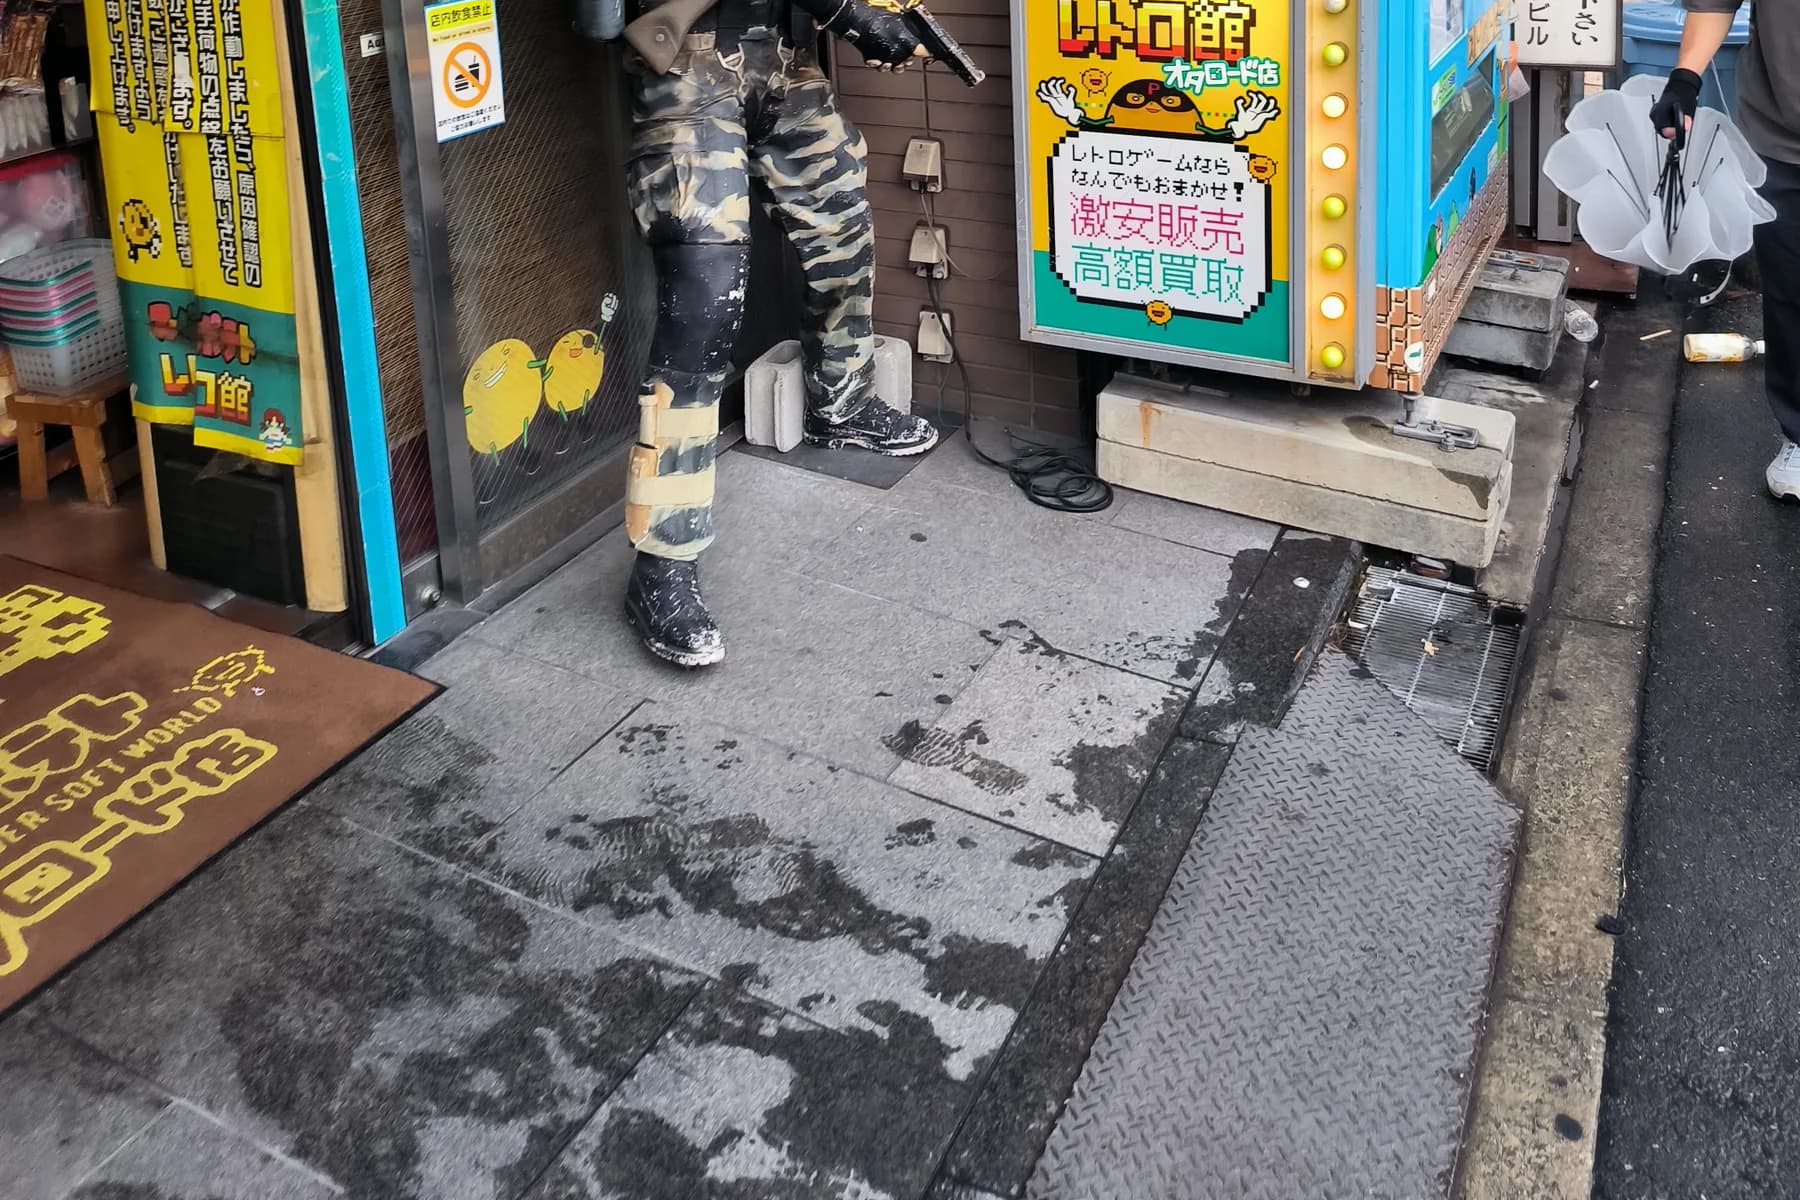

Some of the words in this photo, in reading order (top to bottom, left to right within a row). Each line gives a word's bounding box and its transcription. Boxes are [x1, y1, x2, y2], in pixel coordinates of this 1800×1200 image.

[1162, 56, 1281, 96] オタロード店
[1071, 143, 1231, 176] レトロゲームなら
[1071, 168, 1245, 202] なんでもおまかせ!
[1069, 191, 1245, 256] 激安販売
[1071, 242, 1246, 306] 高額買取
[0, 810, 50, 851] ER
[44, 757, 126, 812] SOFT
[120, 696, 223, 759] WORLD
